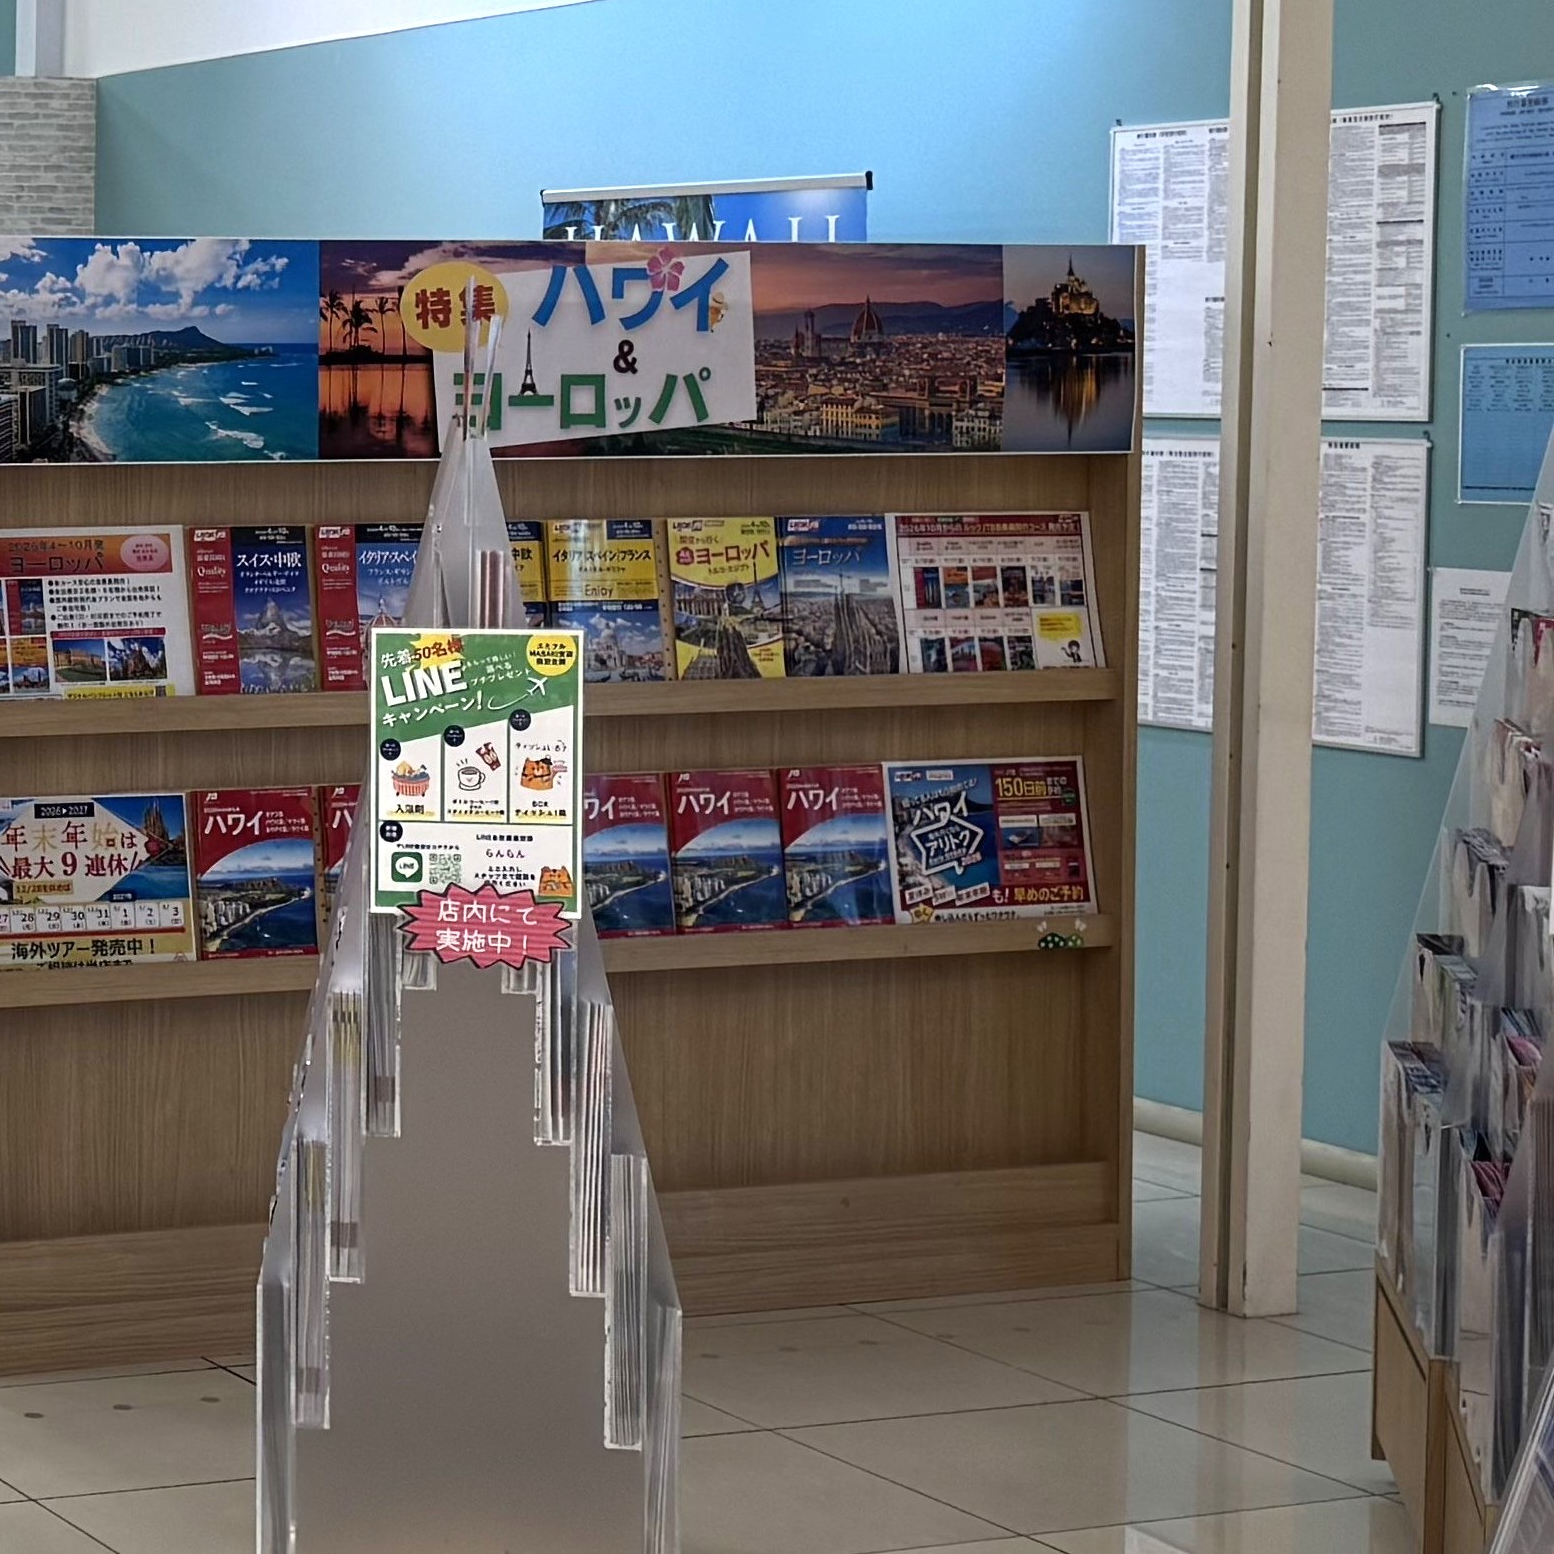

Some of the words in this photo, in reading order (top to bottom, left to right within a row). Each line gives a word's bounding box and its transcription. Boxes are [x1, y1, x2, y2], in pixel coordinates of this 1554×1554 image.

[415, 284, 497, 330] 特集
[532, 257, 729, 332] ハワイ
[612, 339, 639, 375] &
[453, 366, 712, 431] ヨーロッパ
[9, 552, 105, 573] ヨーロッパ
[236, 552, 302, 568] スイス・中欧
[695, 539, 770, 565] ヨーロッパ
[793, 548, 860, 566] ヨーロッパ
[381, 660, 468, 707] LINE
[583, 795, 615, 820] ワイ
[677, 791, 731, 815] ハワイ
[787, 786, 840, 811] ハワイ
[912, 791, 969, 826] ハワイ
[204, 810, 263, 835] ハワイ
[1, 820, 137, 852] 年末年始は
[11, 851, 129, 880] 最大9連休
[437, 900, 538, 925] 店内にて
[11, 938, 156, 960] 海外ツアー発売中！
[435, 928, 529, 956] 実施中！
